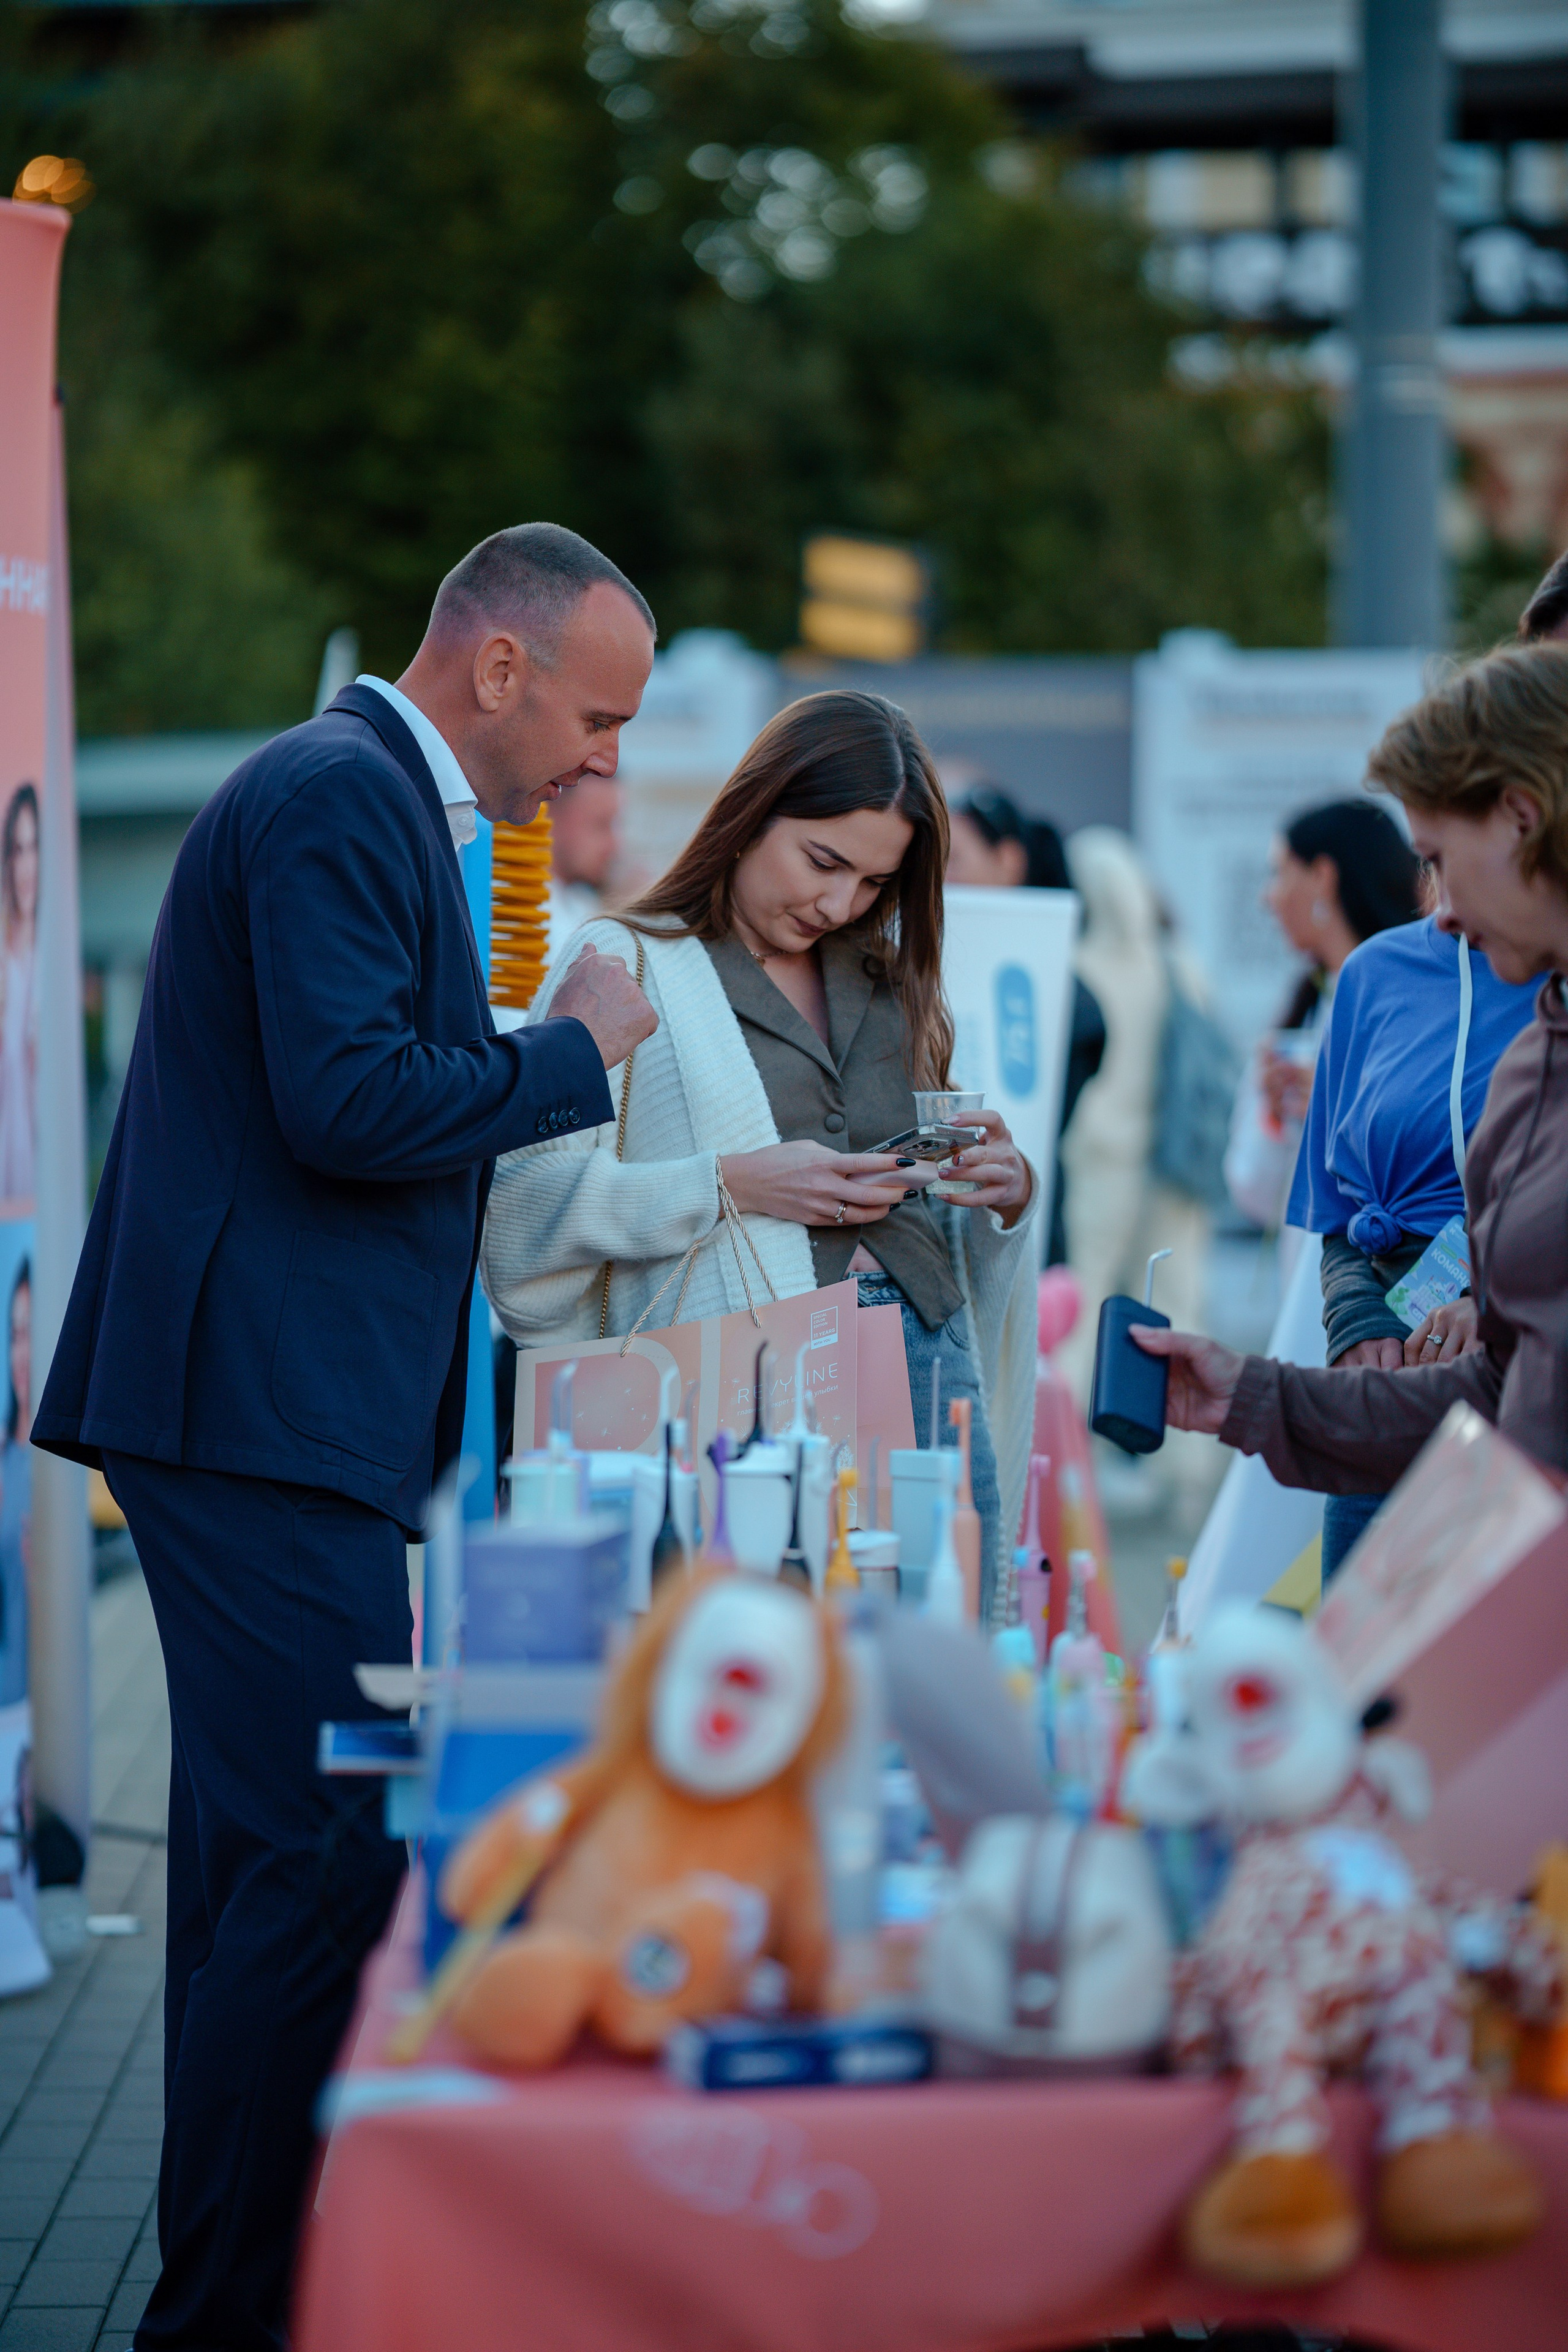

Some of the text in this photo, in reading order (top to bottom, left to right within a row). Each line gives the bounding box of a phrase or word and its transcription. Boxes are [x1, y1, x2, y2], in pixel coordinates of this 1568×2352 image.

[819, 1328, 835, 1336] YEARS
[768, 1398, 790, 1408] екрет
[814, 1384, 839, 1397] улыбки
